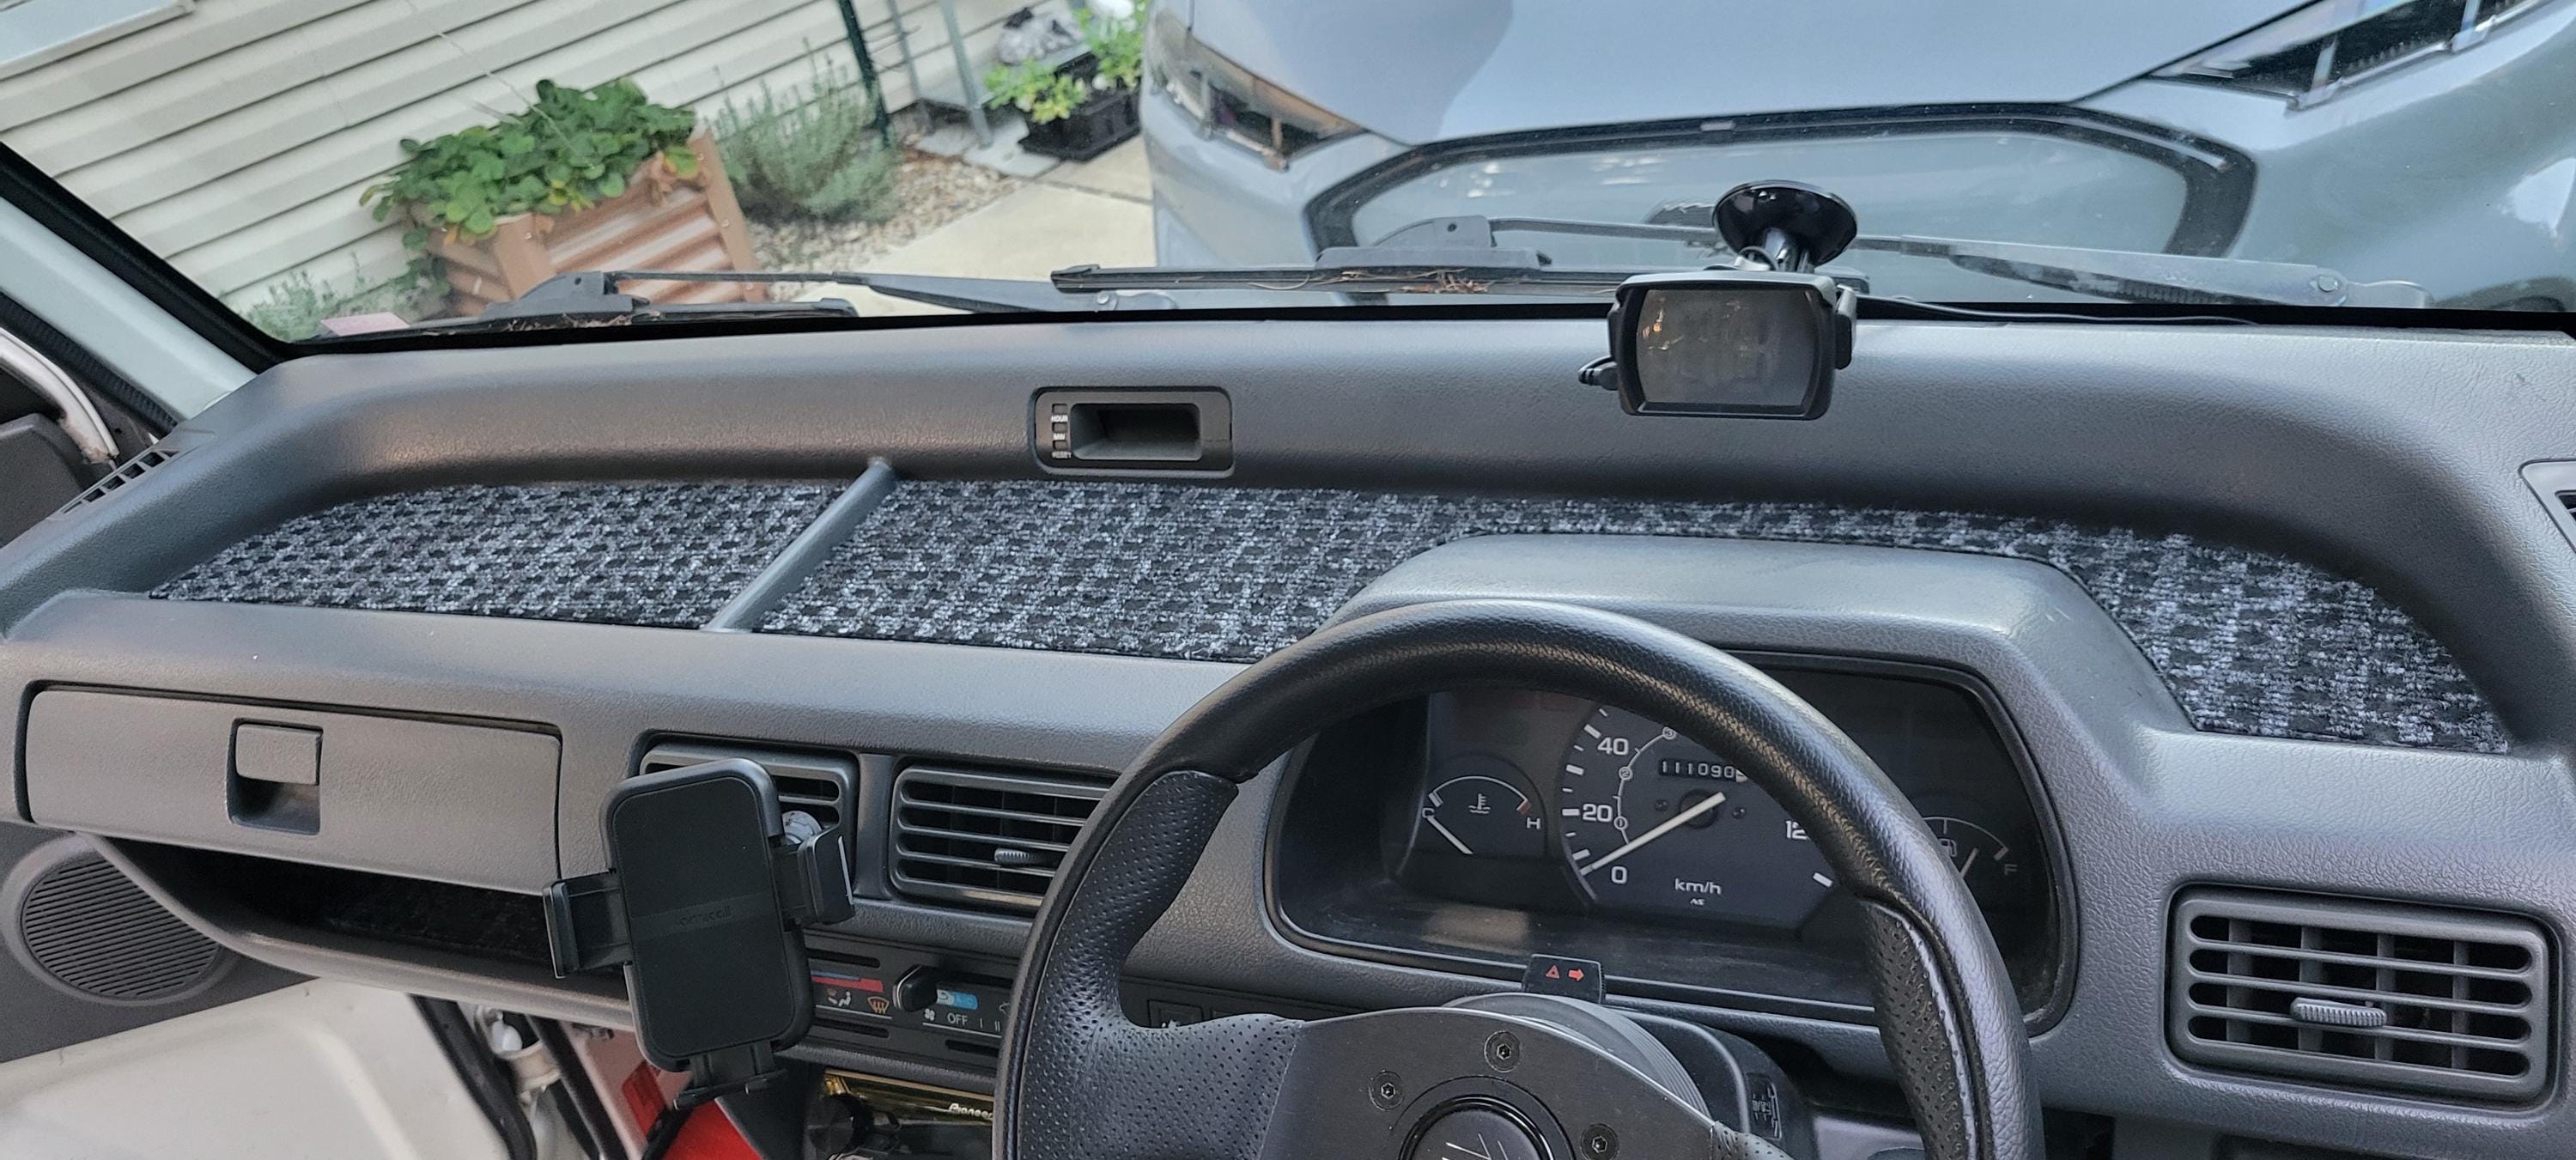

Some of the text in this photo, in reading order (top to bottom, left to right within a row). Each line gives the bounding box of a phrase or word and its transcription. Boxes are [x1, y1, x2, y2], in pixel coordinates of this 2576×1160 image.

[1597, 737, 1629, 756] 40
[1662, 761, 1748, 782] 111090
[1583, 803, 1613, 823] 20
[1526, 817, 1541, 829] H
[1786, 820, 1810, 841] 12
[1611, 865, 1628, 884] 0
[2004, 864, 2018, 875] F
[1674, 878, 1722, 895] km/h
[947, 1012, 968, 1026] OFF
